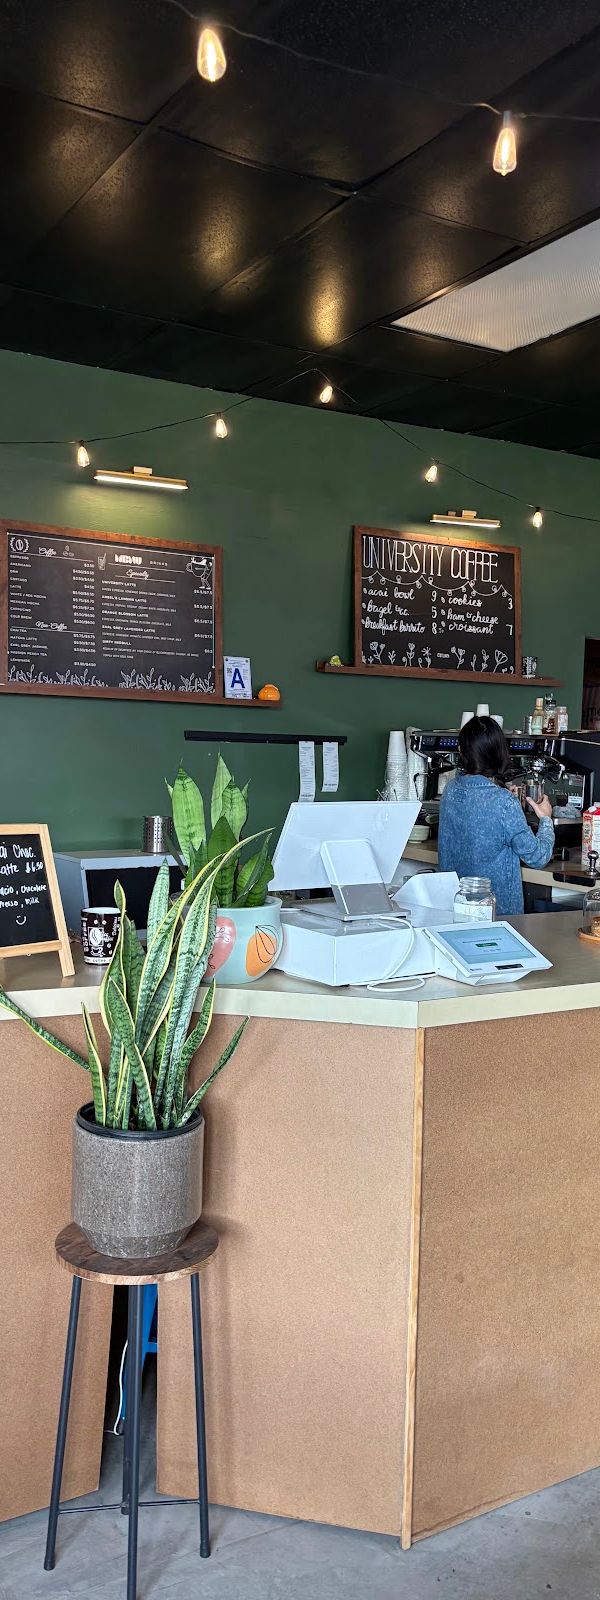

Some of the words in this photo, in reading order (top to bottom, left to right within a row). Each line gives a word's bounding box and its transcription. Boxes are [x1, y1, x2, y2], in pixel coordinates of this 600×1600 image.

[114, 554, 143, 565] MENU
[363, 536, 444, 577] UNIVERSITY
[451, 548, 499, 583] COFFEE
[367, 588, 389, 598] acai
[393, 586, 415, 600] bowl
[431, 590, 437, 602] 9
[448, 594, 483, 608] cookies
[507, 598, 513, 610] 3
[367, 599, 393, 618] bagel
[431, 606, 437, 619] 5
[446, 608, 466, 621] ham
[472, 611, 499, 625] cheese
[364, 616, 399, 636] breakfast
[399, 620, 426, 633] burrito
[448, 621, 494, 634] croissant
[505, 624, 513, 636] 7
[230, 667, 246, 689] A
[0, 862, 20, 876] atte
[25, 861, 44, 874] $6.50
[24, 896, 40, 906] milk
